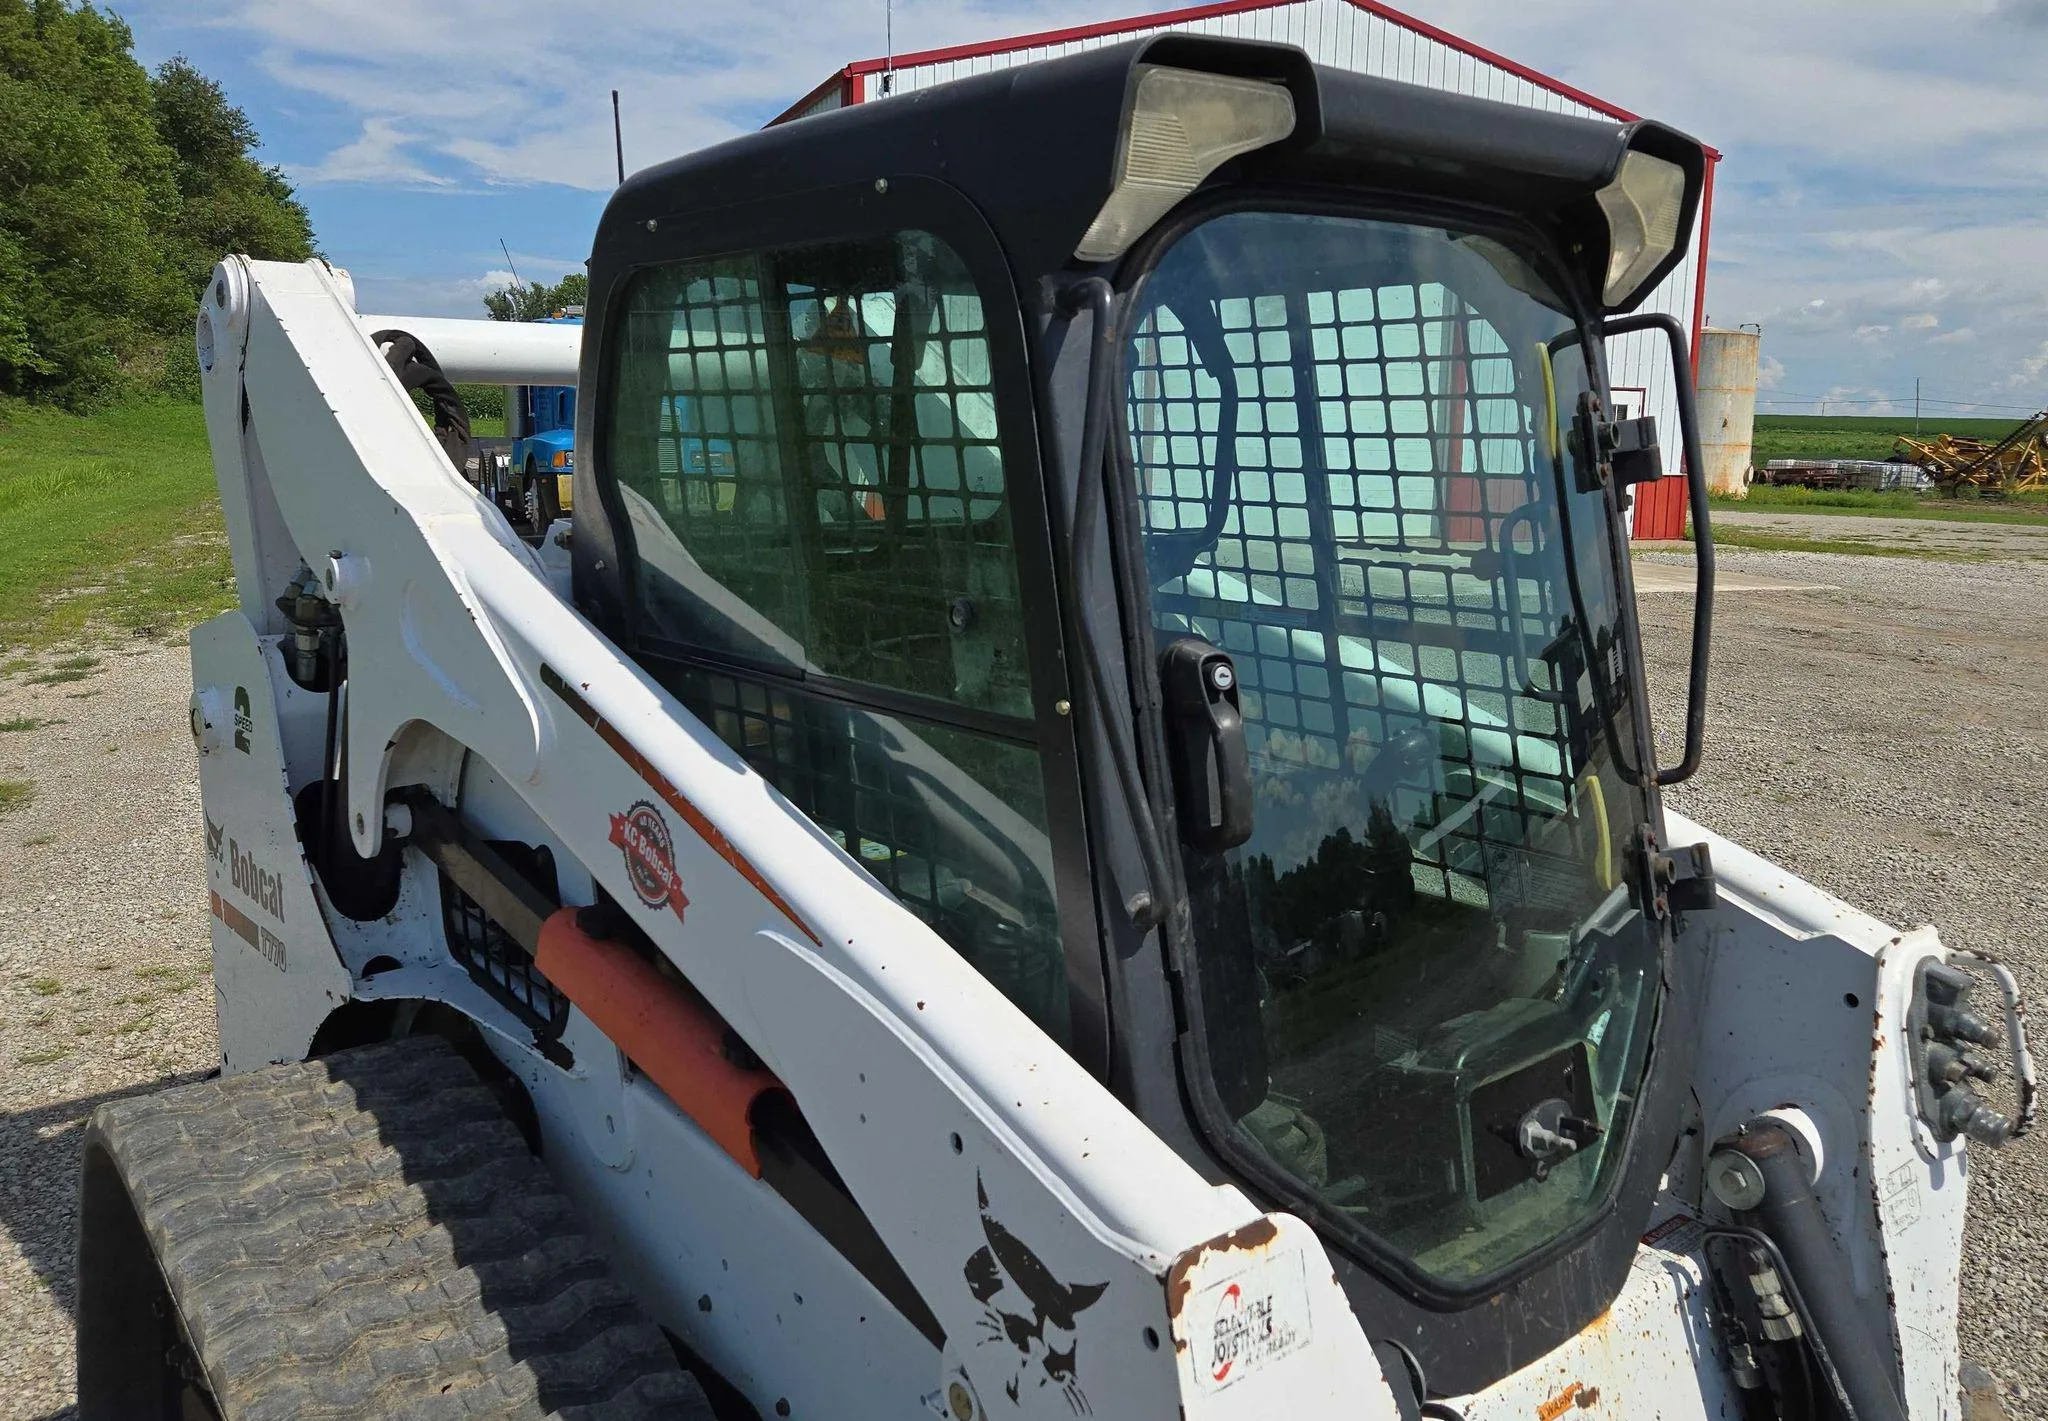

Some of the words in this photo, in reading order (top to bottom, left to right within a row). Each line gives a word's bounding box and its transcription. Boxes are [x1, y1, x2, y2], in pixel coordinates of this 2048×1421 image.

[234, 713, 253, 733] SPEED
[229, 837, 285, 924] Bobcat
[624, 820, 638, 847] KC
[639, 834, 674, 889] Bobcat
